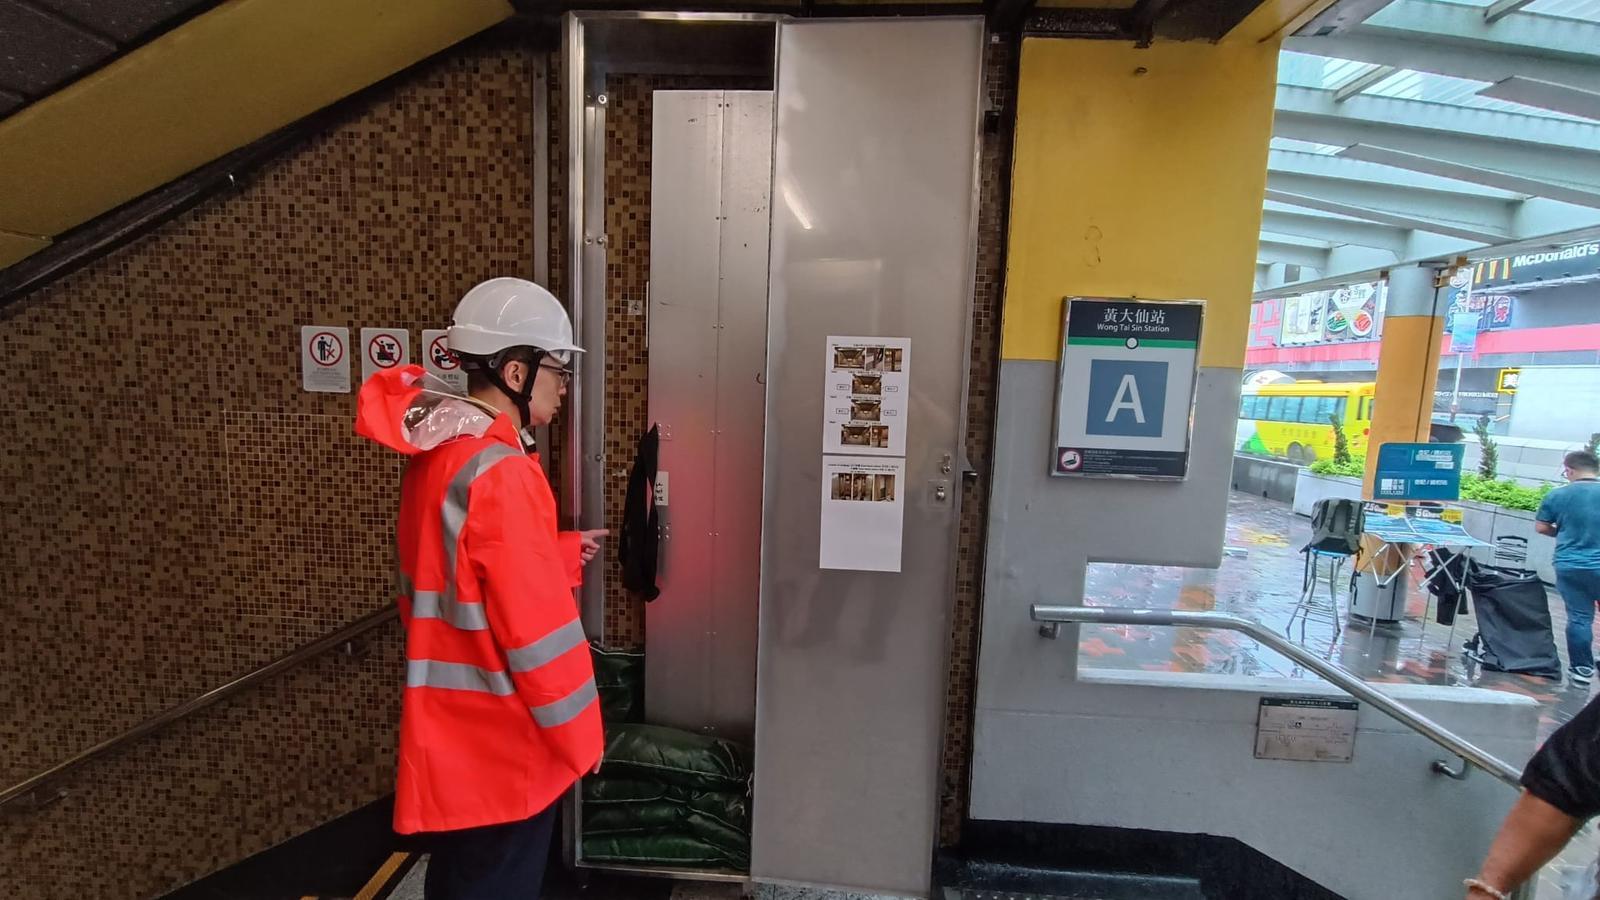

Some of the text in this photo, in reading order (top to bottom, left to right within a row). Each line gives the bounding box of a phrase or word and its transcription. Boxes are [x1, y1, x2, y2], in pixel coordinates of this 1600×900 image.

[1512, 243, 1600, 267] McDonald's
[1103, 307, 1166, 324] 黃大仙站
[1097, 323, 1118, 332] Wong
[1131, 324, 1142, 332] Sin
[1144, 325, 1170, 333] Station
[1104, 374, 1146, 423] A
